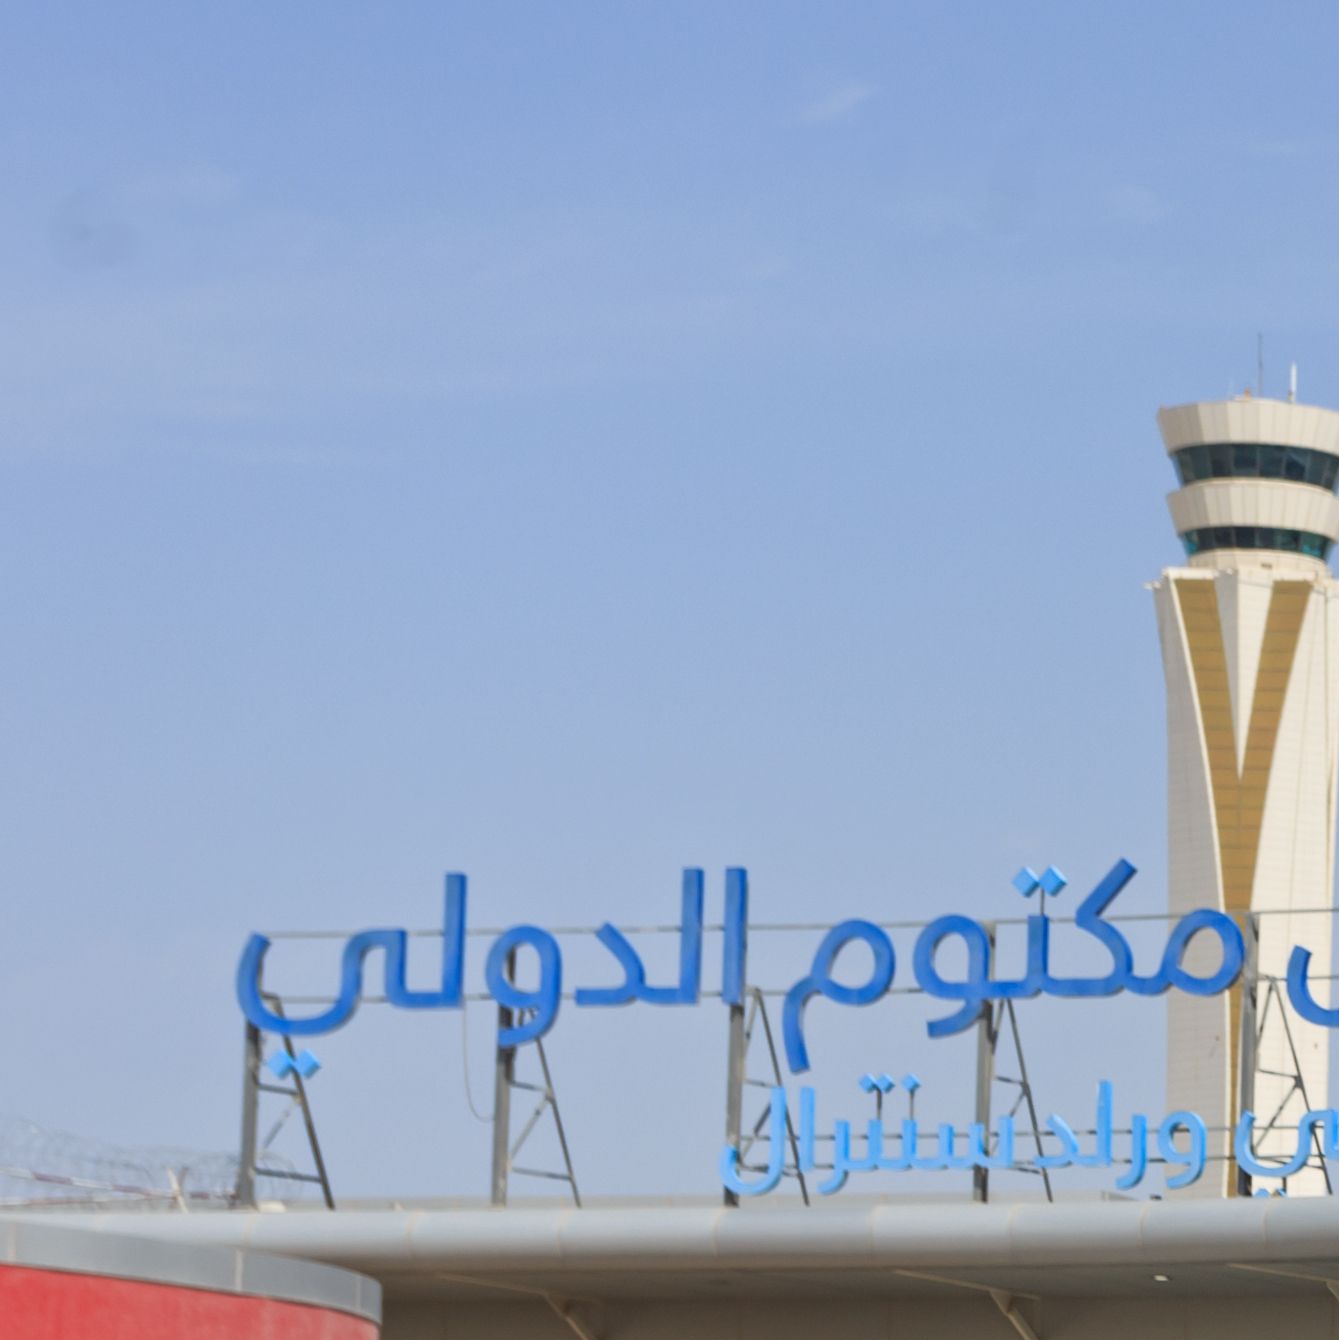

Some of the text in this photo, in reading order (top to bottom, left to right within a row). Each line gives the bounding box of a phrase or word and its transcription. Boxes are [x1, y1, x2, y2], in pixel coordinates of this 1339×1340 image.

[236, 864, 748, 1079] الدولي
[782, 857, 1246, 1075] مكتوم
[1033, 1080, 1207, 1190] ورلد
